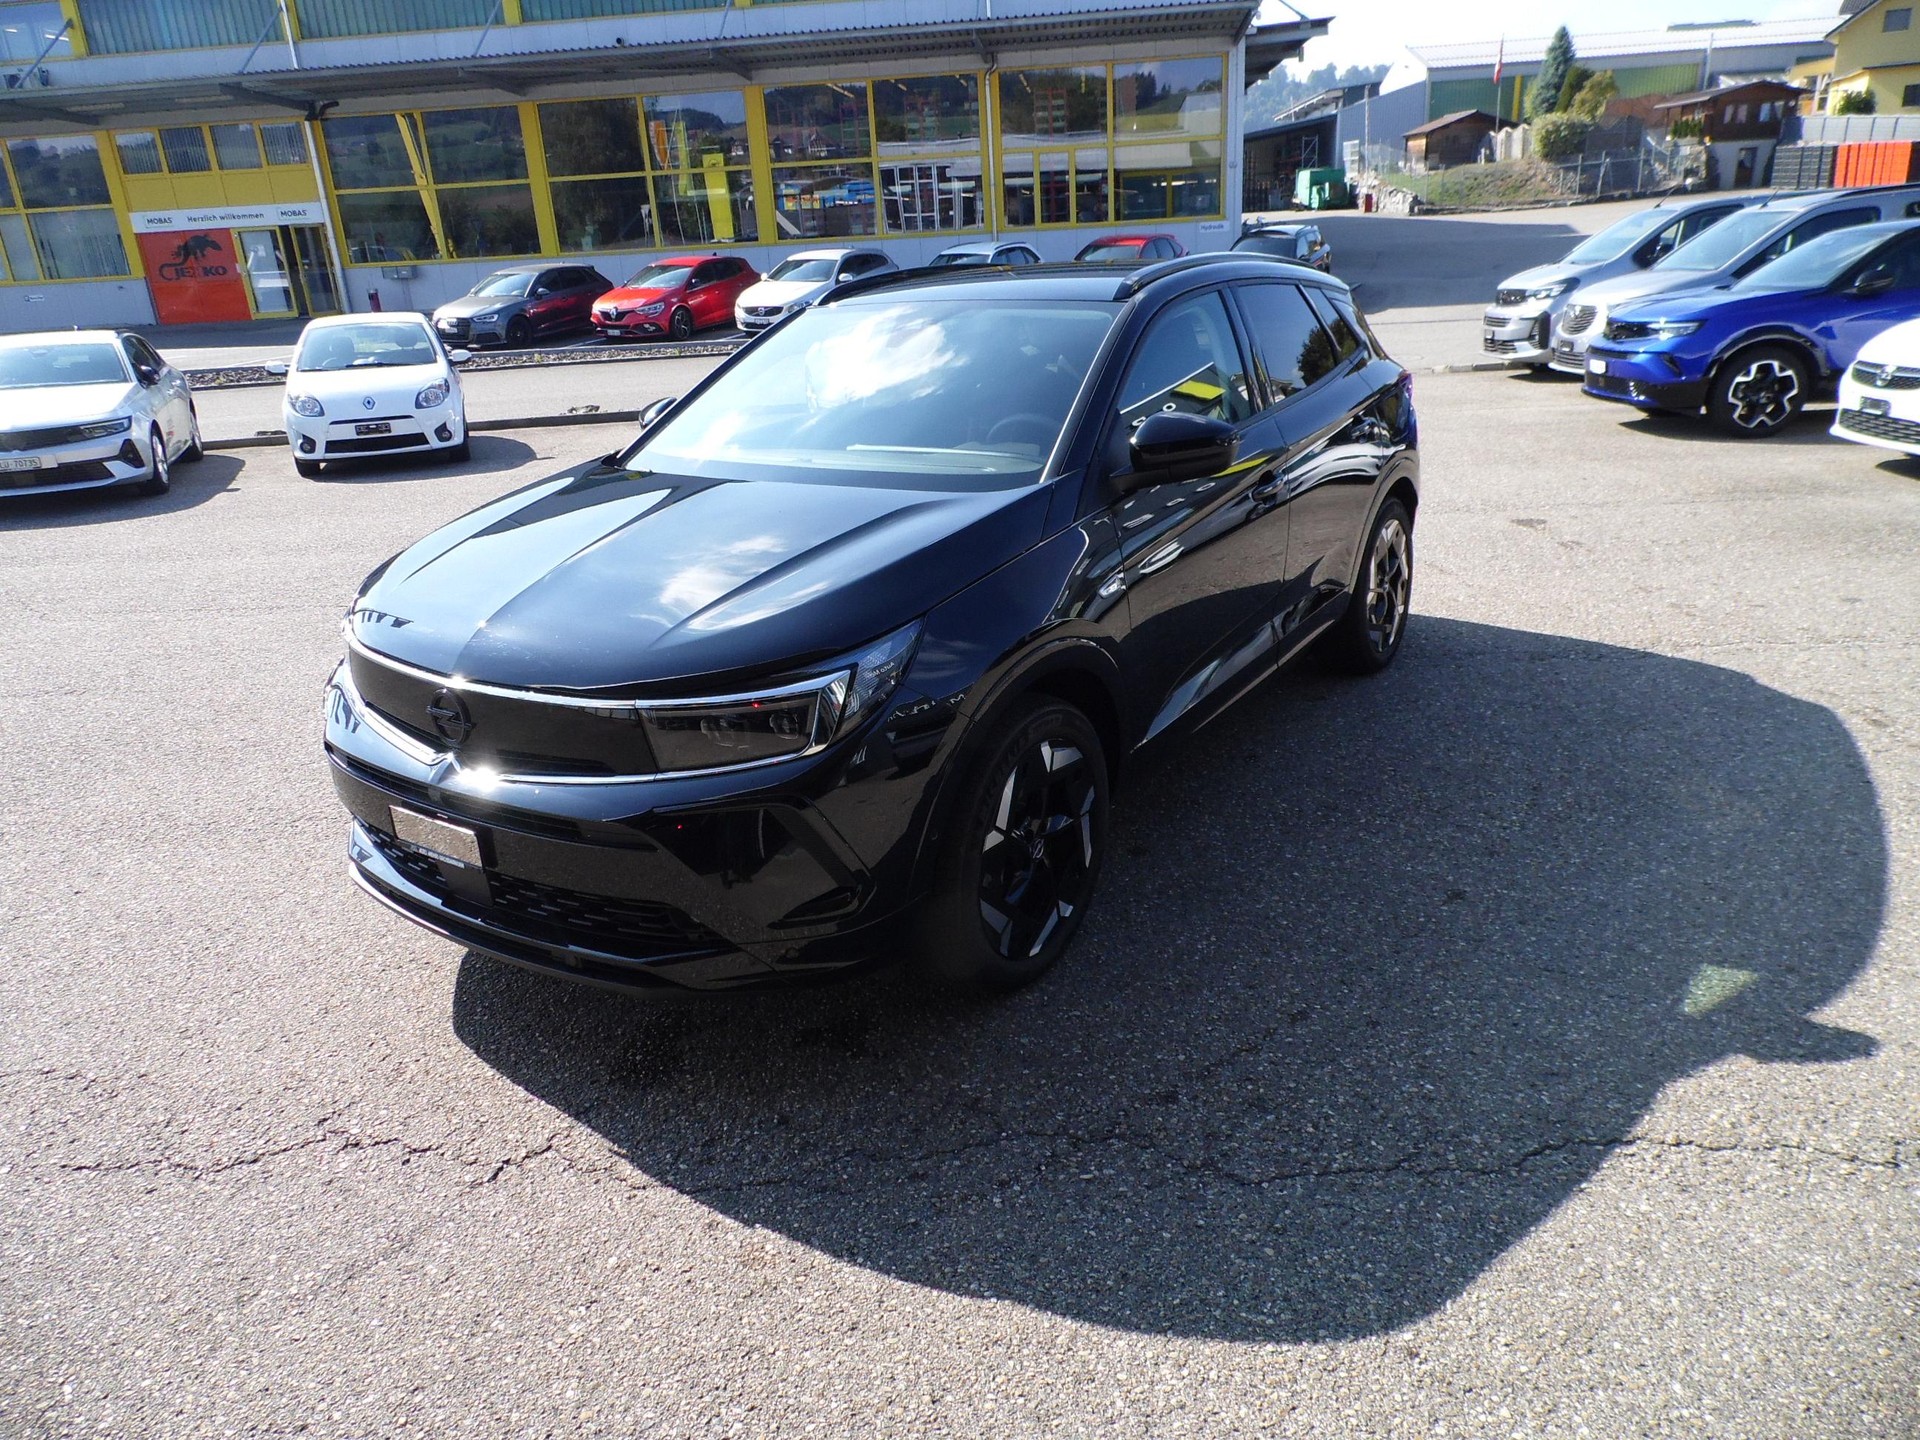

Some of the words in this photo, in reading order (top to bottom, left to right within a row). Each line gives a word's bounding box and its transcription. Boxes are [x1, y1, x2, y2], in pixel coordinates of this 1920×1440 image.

[186, 214, 218, 223] Herzlich
[219, 212, 265, 222] willkommen
[279, 209, 308, 218] MOBAS
[146, 217, 173, 225] MOBAS
